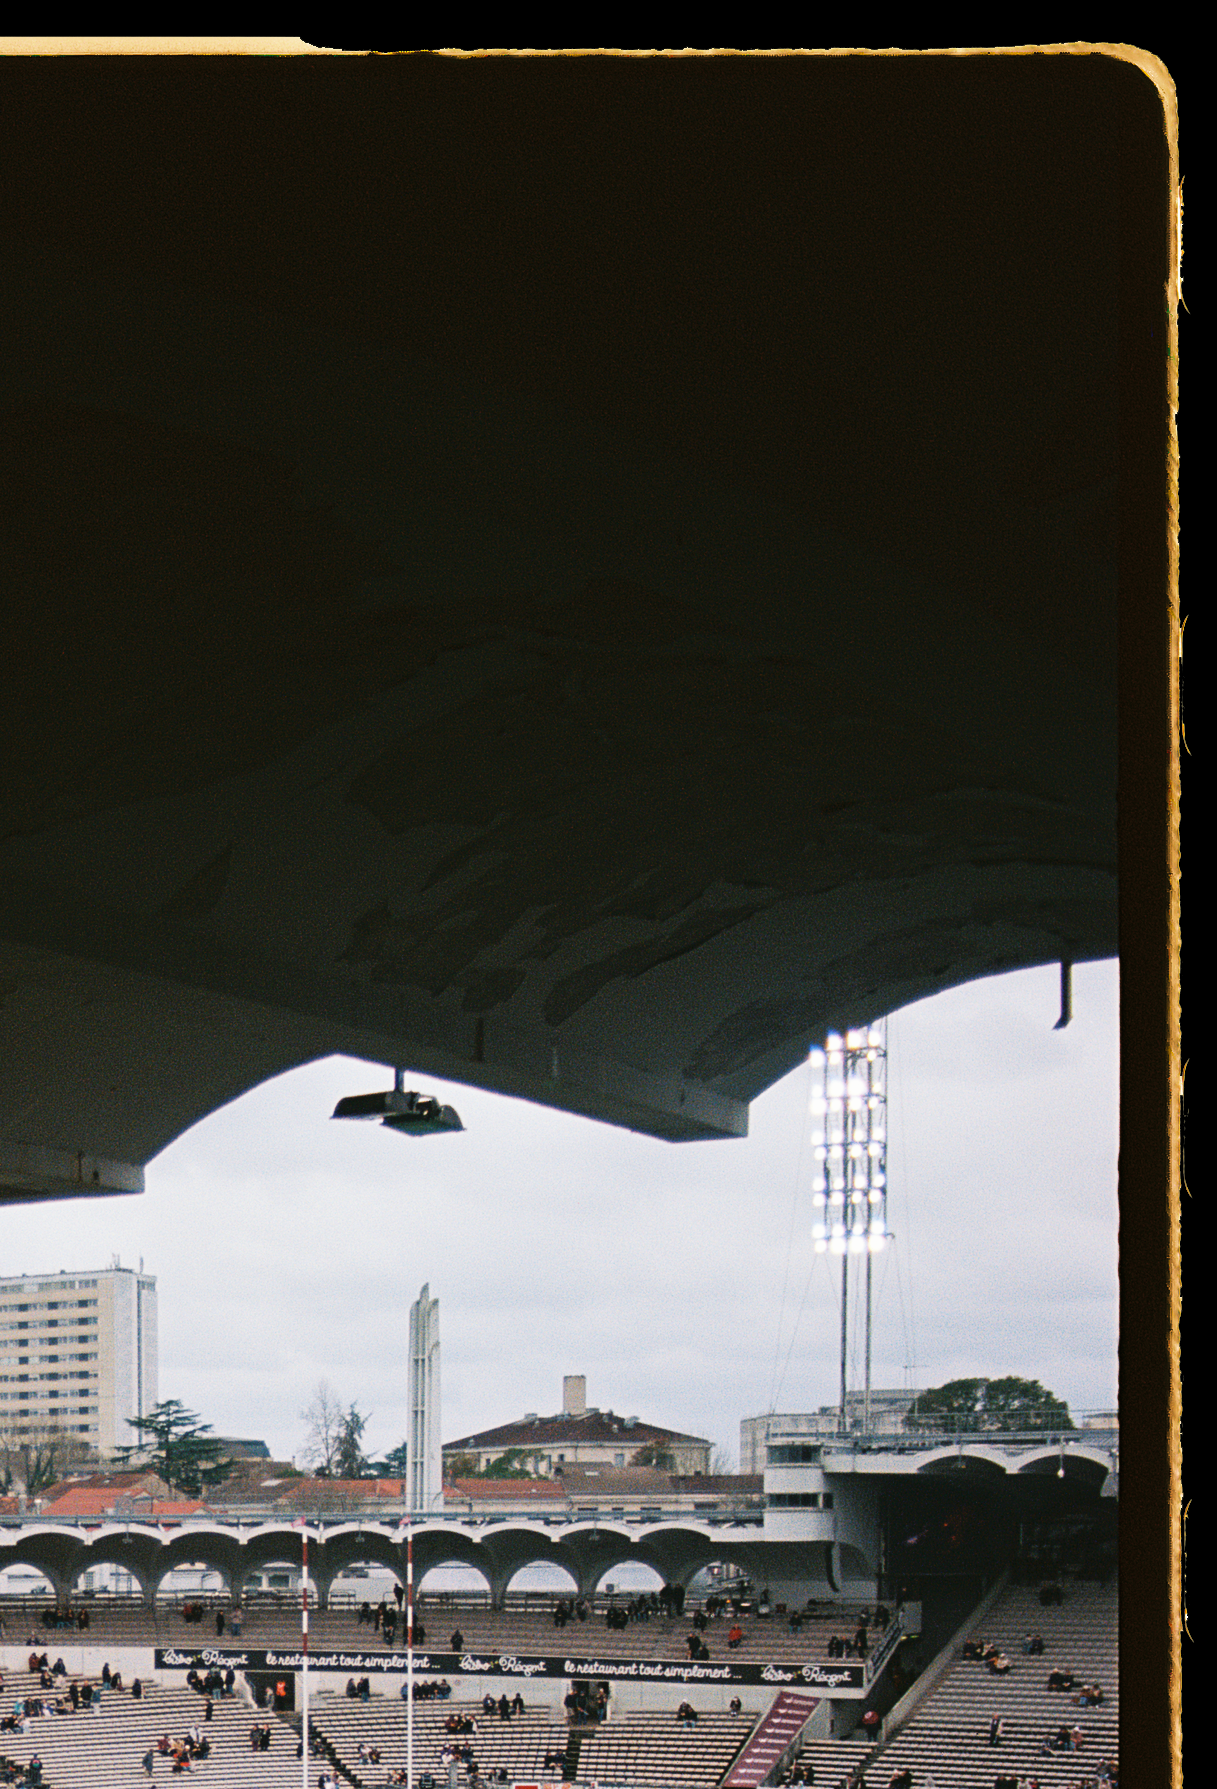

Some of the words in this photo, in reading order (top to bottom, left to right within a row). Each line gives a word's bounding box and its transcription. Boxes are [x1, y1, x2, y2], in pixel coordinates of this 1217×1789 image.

[266, 1653, 278, 1665] le
[339, 1654, 364, 1666] tout
[564, 1660, 576, 1672] le
[576, 1661, 639, 1675] restaurant
[639, 1663, 664, 1676] tout
